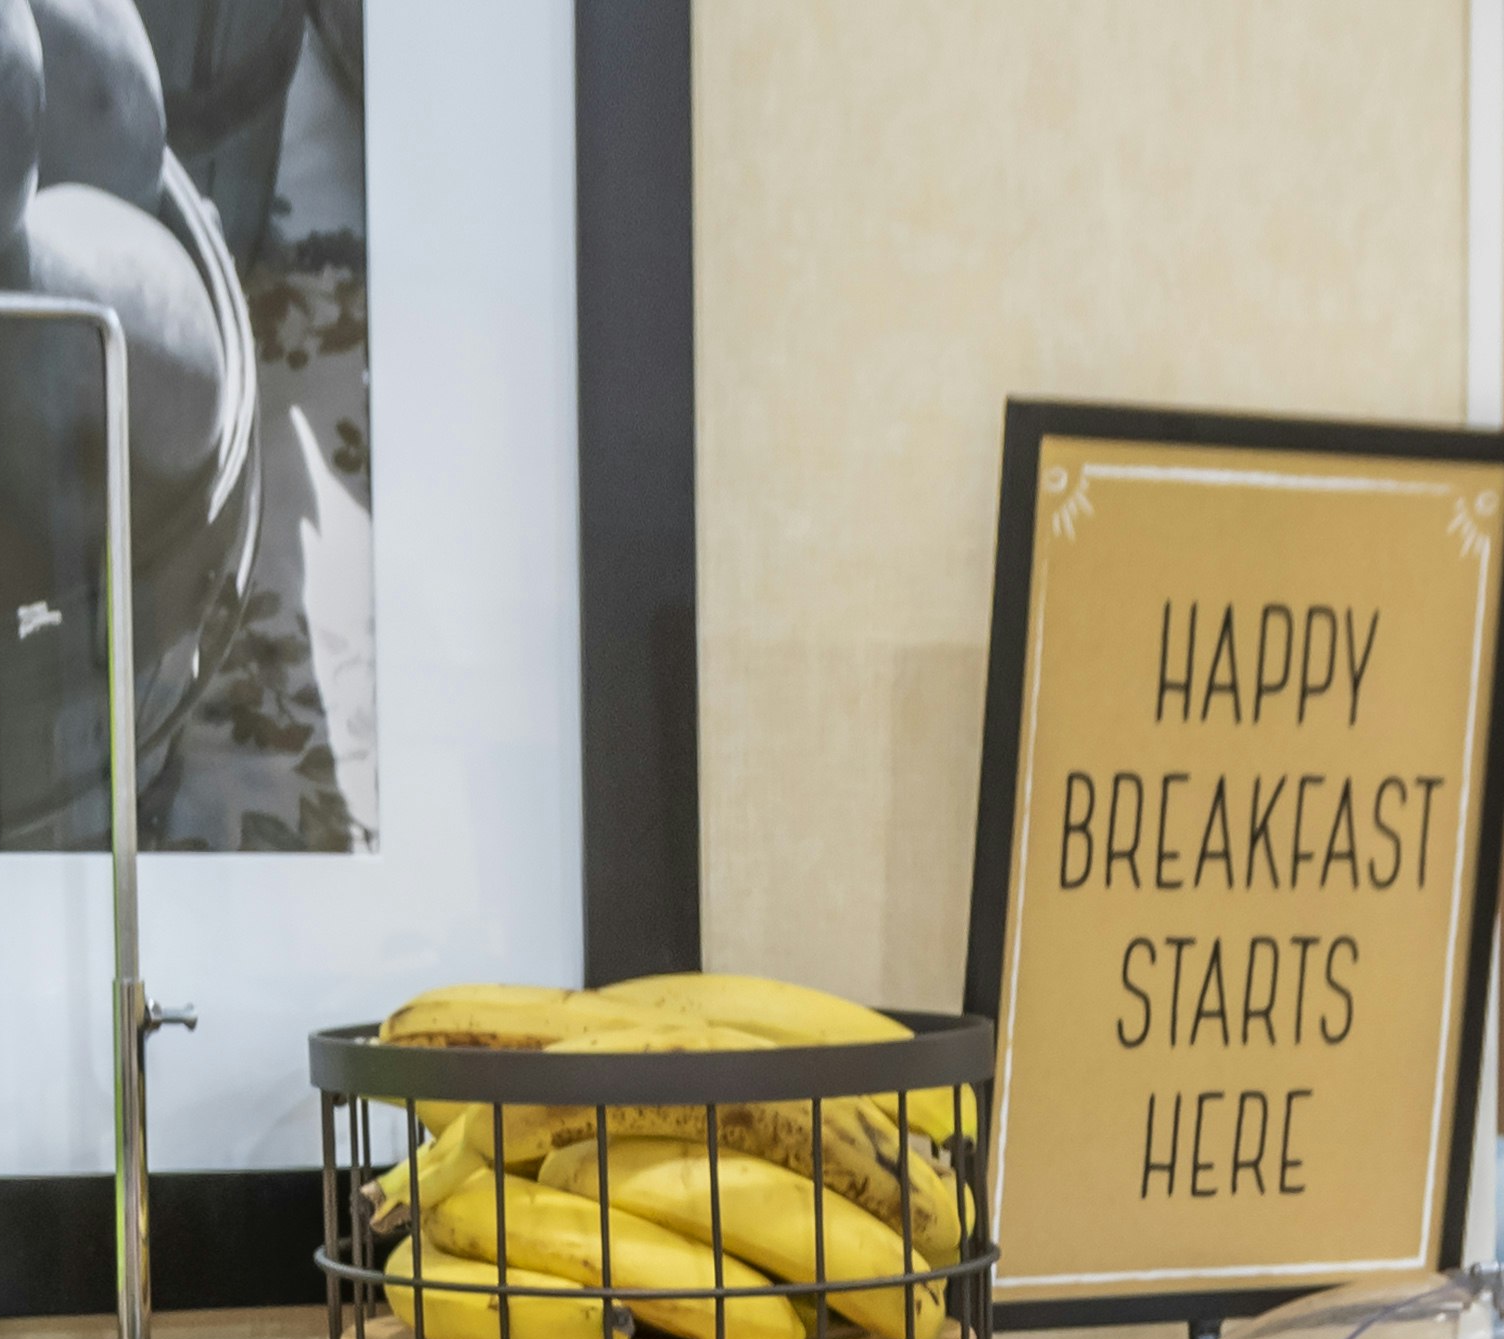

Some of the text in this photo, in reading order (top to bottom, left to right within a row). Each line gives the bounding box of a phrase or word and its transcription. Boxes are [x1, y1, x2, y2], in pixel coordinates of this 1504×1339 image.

[1156, 599, 1379, 725] HAPPY
[1059, 771, 1444, 890] BREAKFAST
[1116, 936, 1359, 1047] STARTS
[1141, 1090, 1313, 1199] HERE
